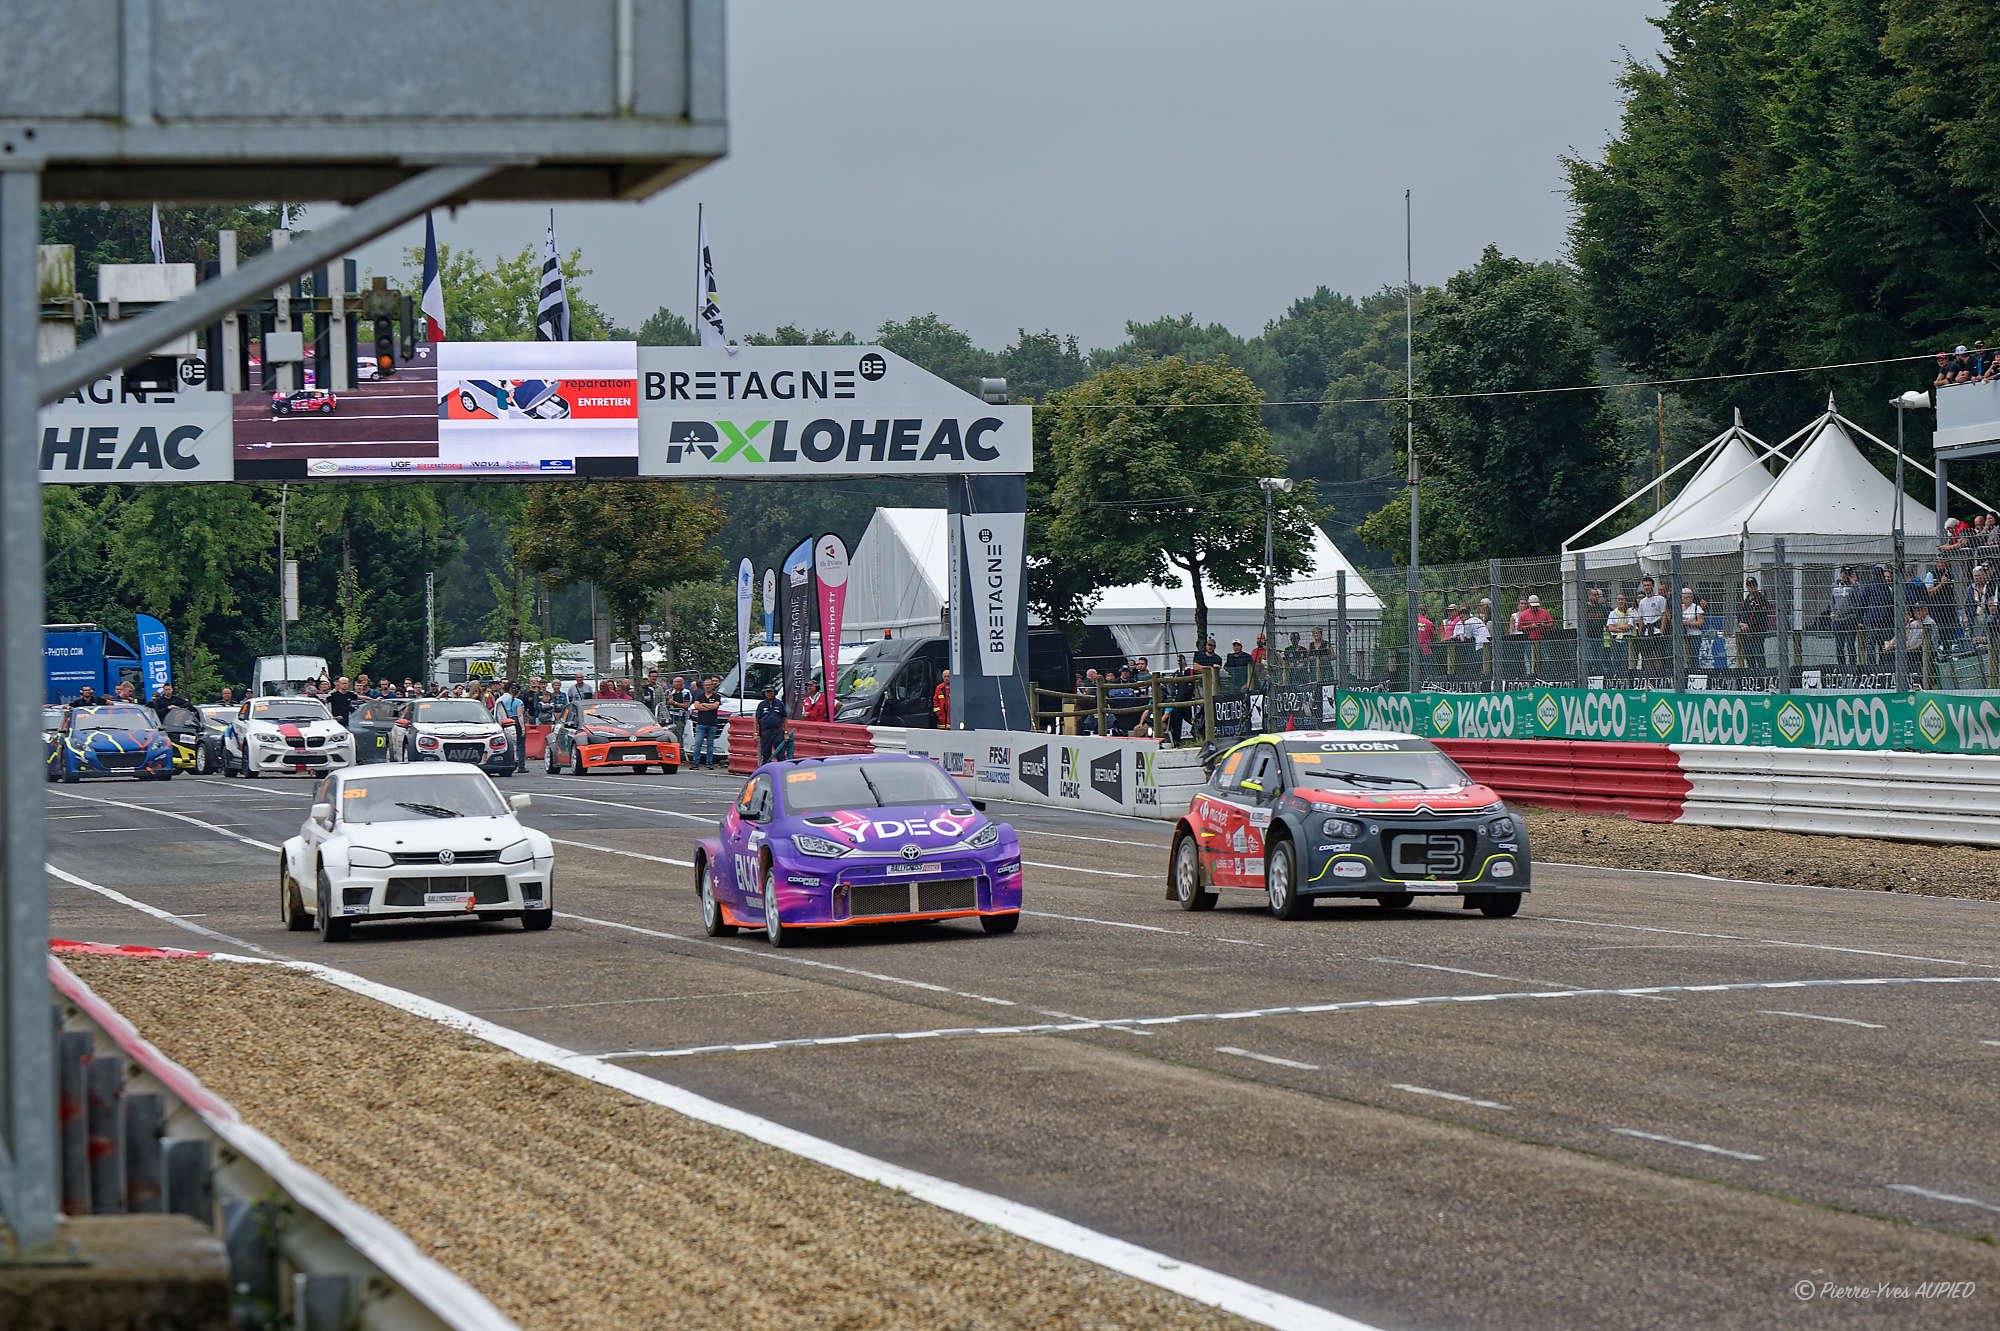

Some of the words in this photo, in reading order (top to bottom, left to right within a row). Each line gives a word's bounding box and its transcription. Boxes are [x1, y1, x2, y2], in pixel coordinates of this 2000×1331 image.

[578, 397, 631, 406] ENTRETIEN
[644, 371, 855, 400] BRETAGNE
[987, 544, 1004, 653] BRETAGNE
[1359, 696, 1413, 734] YACCO
[1457, 695, 1514, 738] YACCO
[1560, 692, 1626, 737] YACCO
[1677, 698, 1748, 745] YACCO
[1805, 697, 1889, 746] YACCO
[450, 749, 480, 760] AVIA
[1320, 742, 1400, 751] CITROËN
[1060, 781, 1080, 799] LOHEAC
[1135, 787, 1157, 805] LOHEAC
[1390, 834, 1464, 875] C3
